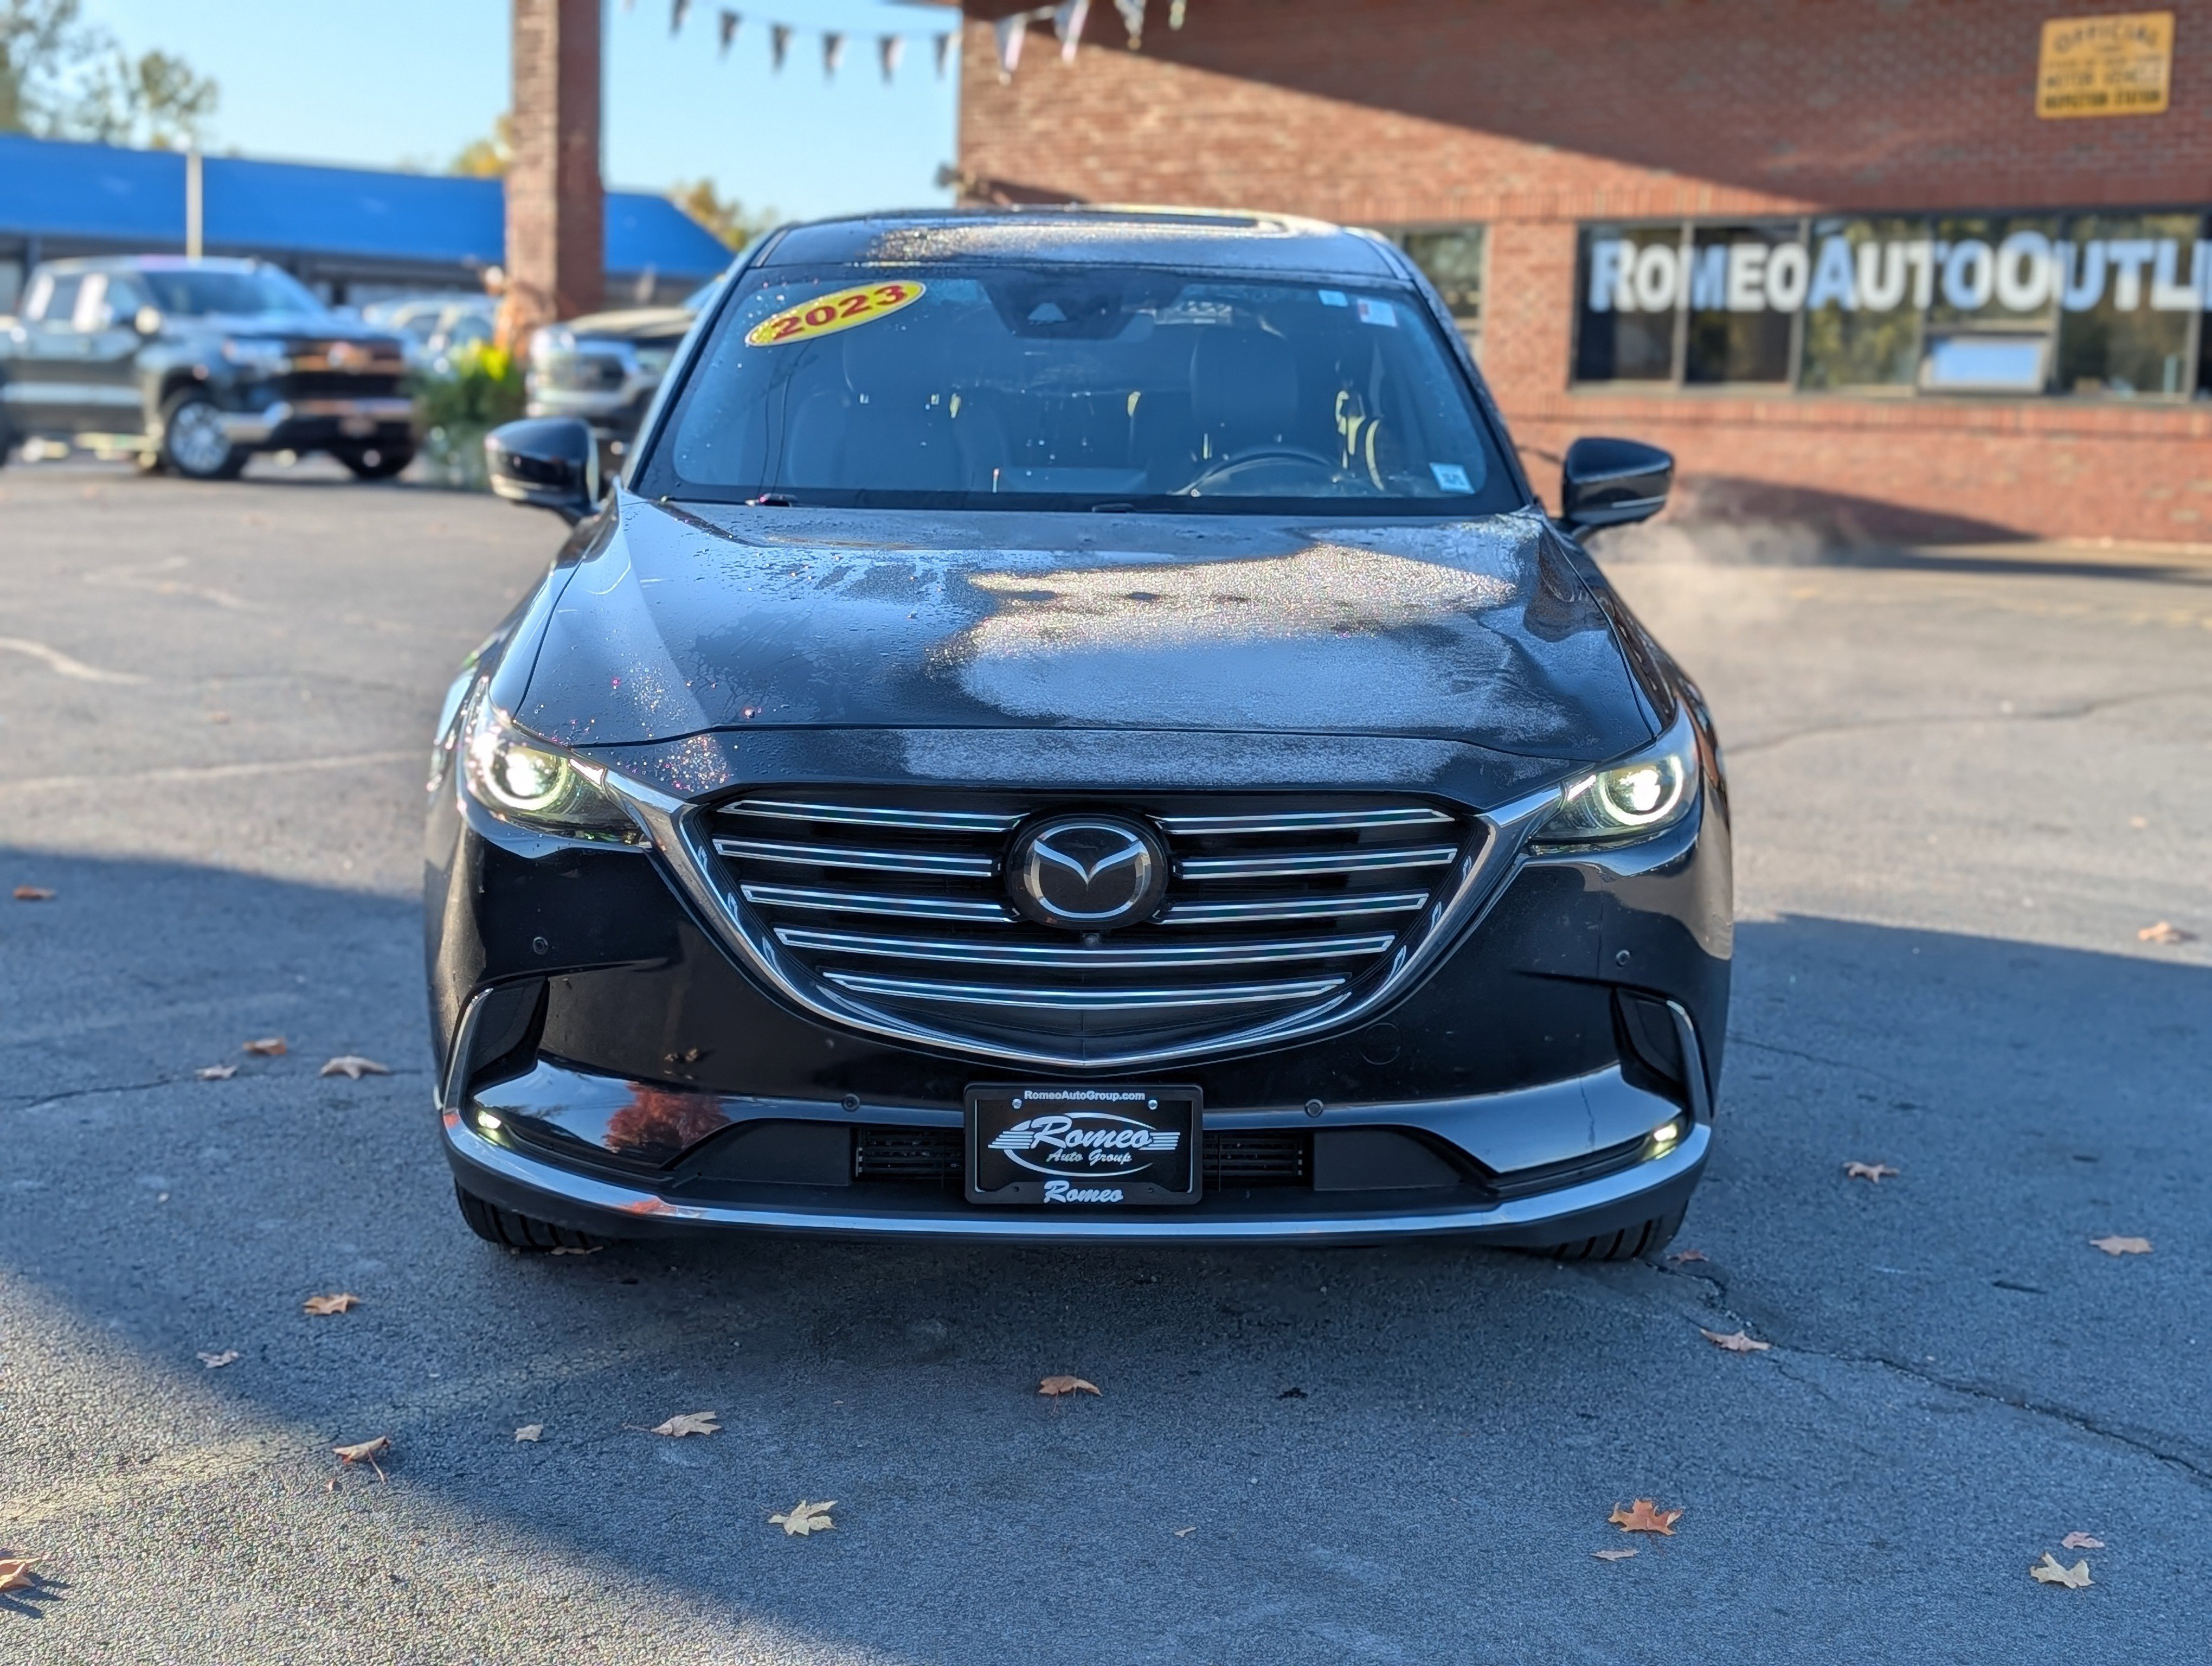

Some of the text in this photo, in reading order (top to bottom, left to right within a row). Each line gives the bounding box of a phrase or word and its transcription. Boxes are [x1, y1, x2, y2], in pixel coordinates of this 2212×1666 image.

[771, 285, 908, 341] 2023
[1024, 1090, 1146, 1101] RomeoAutoGroup.com
[1031, 1116, 1153, 1149] Romeo
[1046, 1148, 1133, 1166] Auto Group
[1043, 1180, 1124, 1203] Romeo
